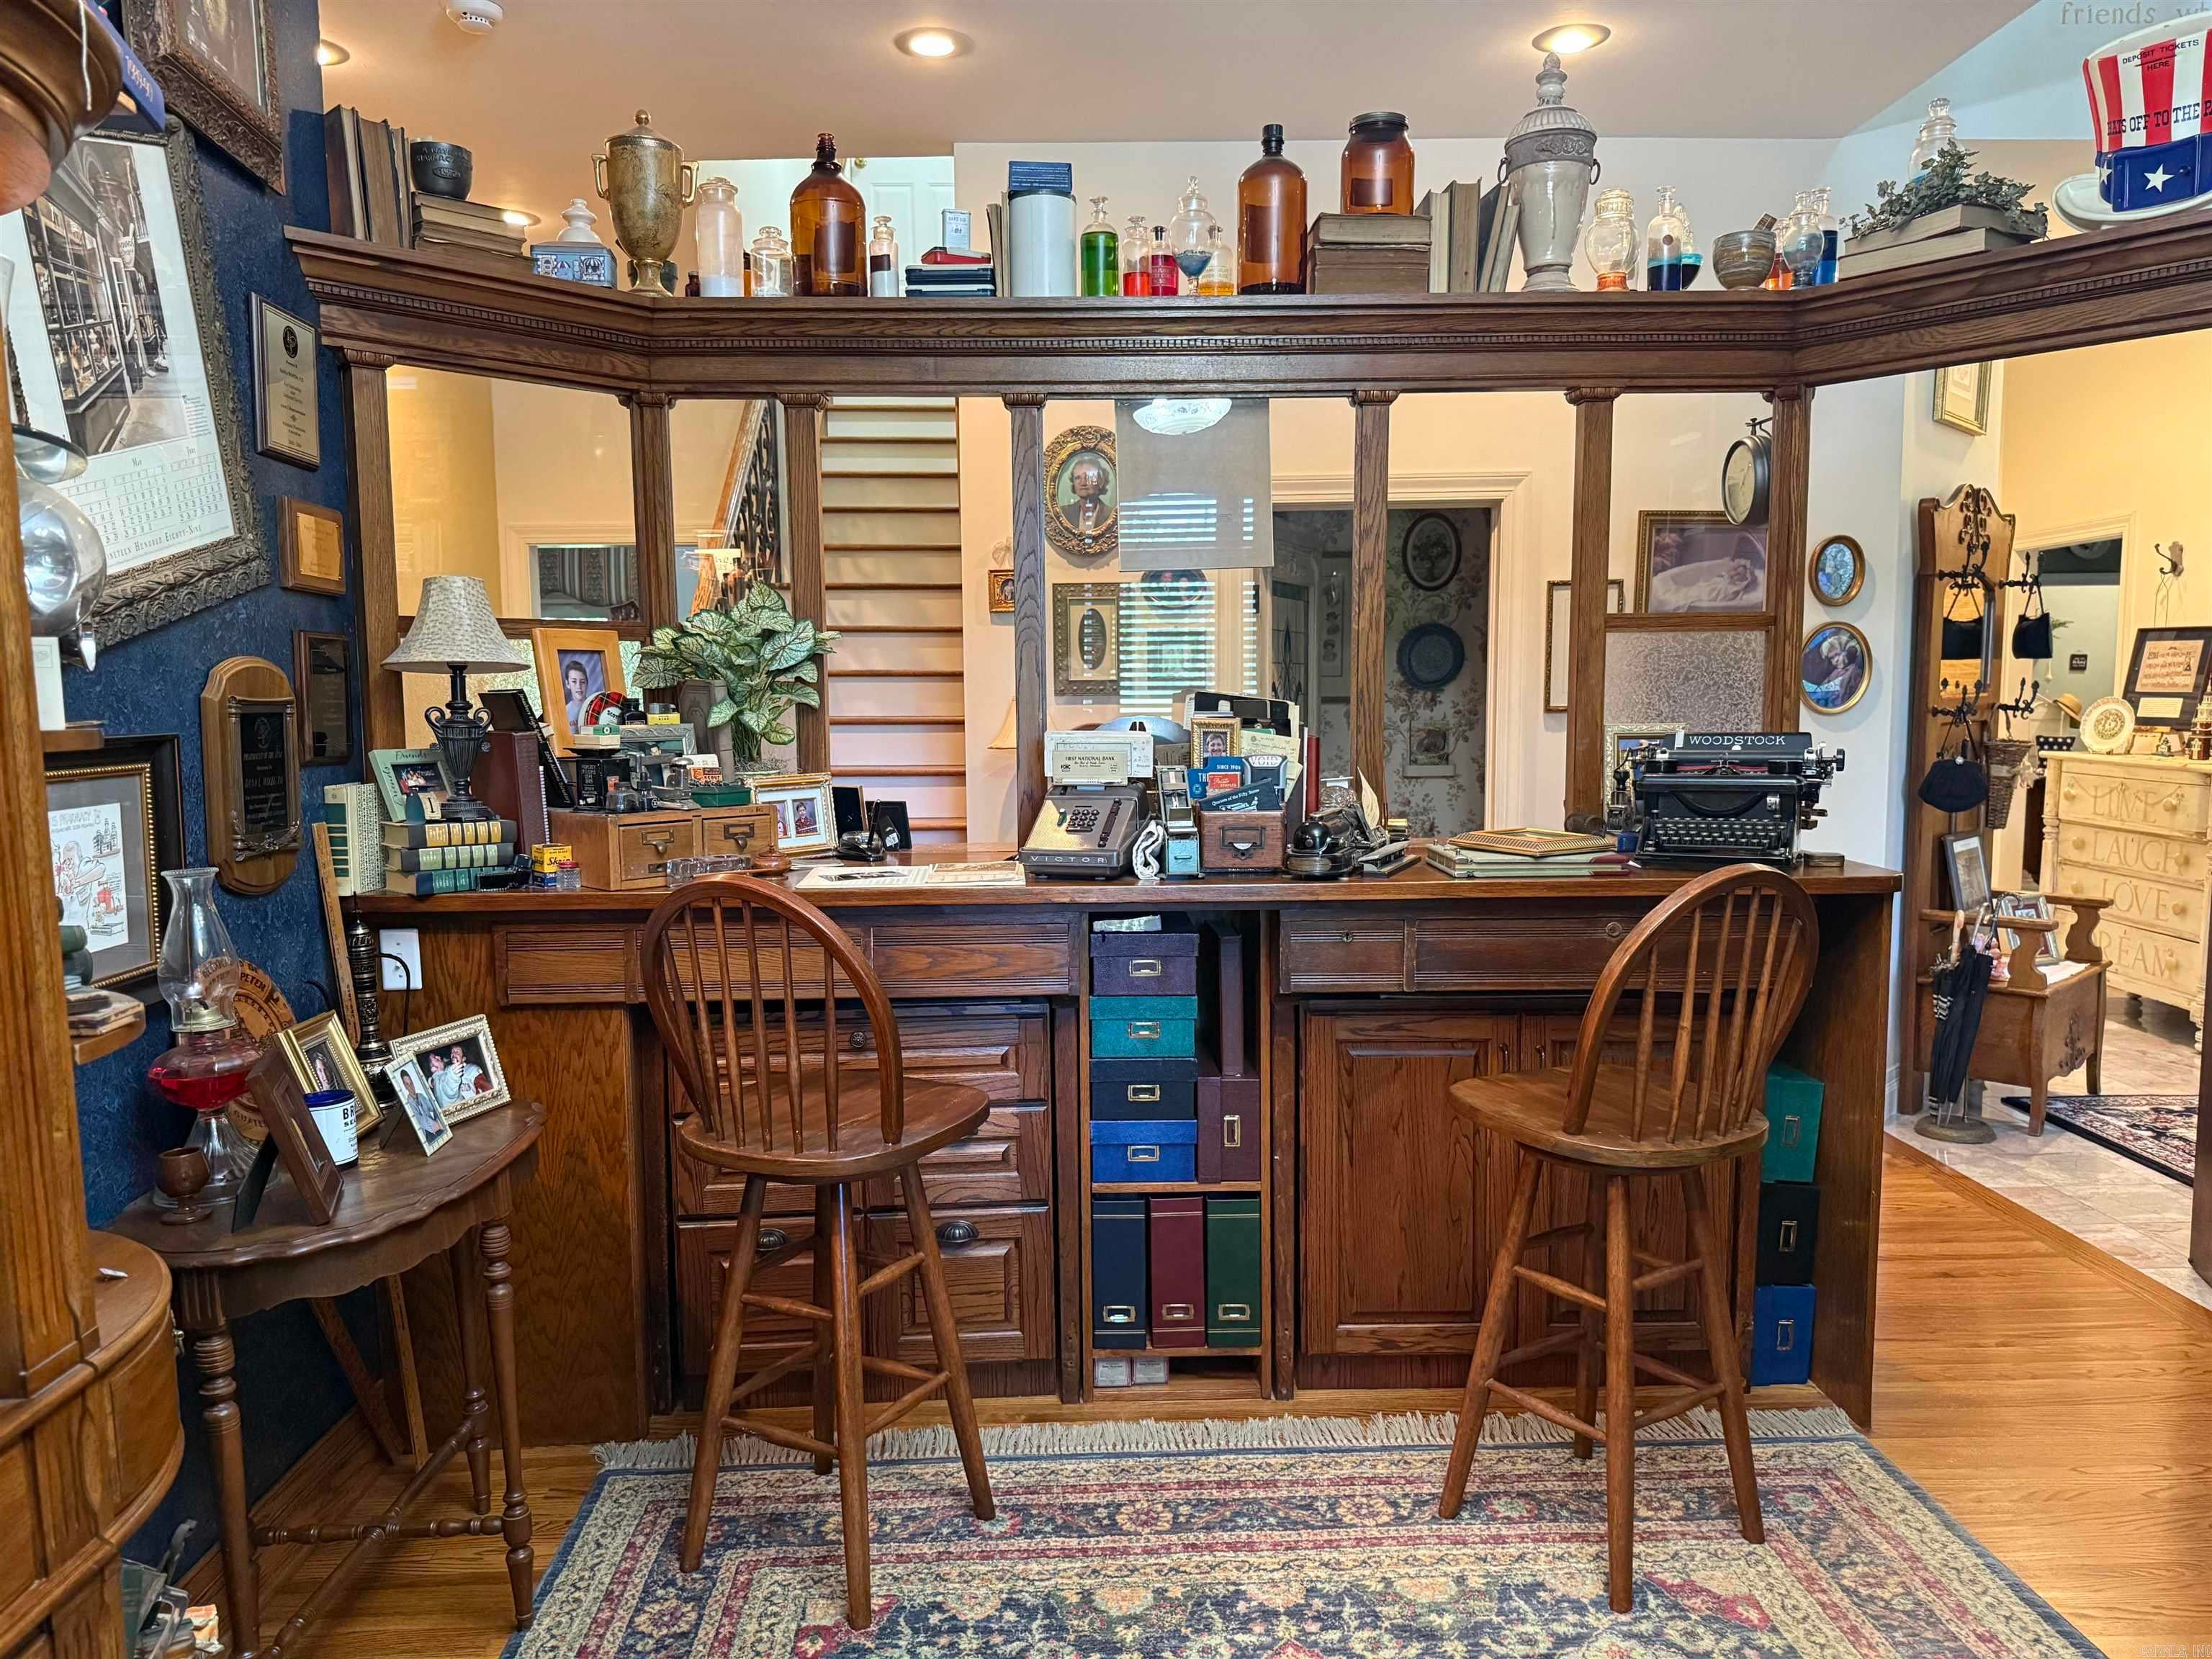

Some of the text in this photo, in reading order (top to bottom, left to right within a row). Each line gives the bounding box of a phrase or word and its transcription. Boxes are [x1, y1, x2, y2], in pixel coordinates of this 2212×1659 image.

[2062, 1, 2157, 24] friends
[2122, 39, 2200, 64] DEPOSIT TICKETS
[2146, 60, 2170, 71] HERE
[2129, 114, 2150, 132] OFF
[2154, 109, 2170, 127] TO
[2172, 102, 2200, 124] THE
[1689, 735, 1786, 745] WOODSTOCK
[1251, 756, 1279, 766] VOID
[1030, 855, 1105, 864] VICTOR
[2091, 830, 2184, 877] LAUGH
[2102, 878, 2170, 922] LOVE
[2098, 929, 2177, 979] REAM
[240, 972, 266, 992] PETEN
